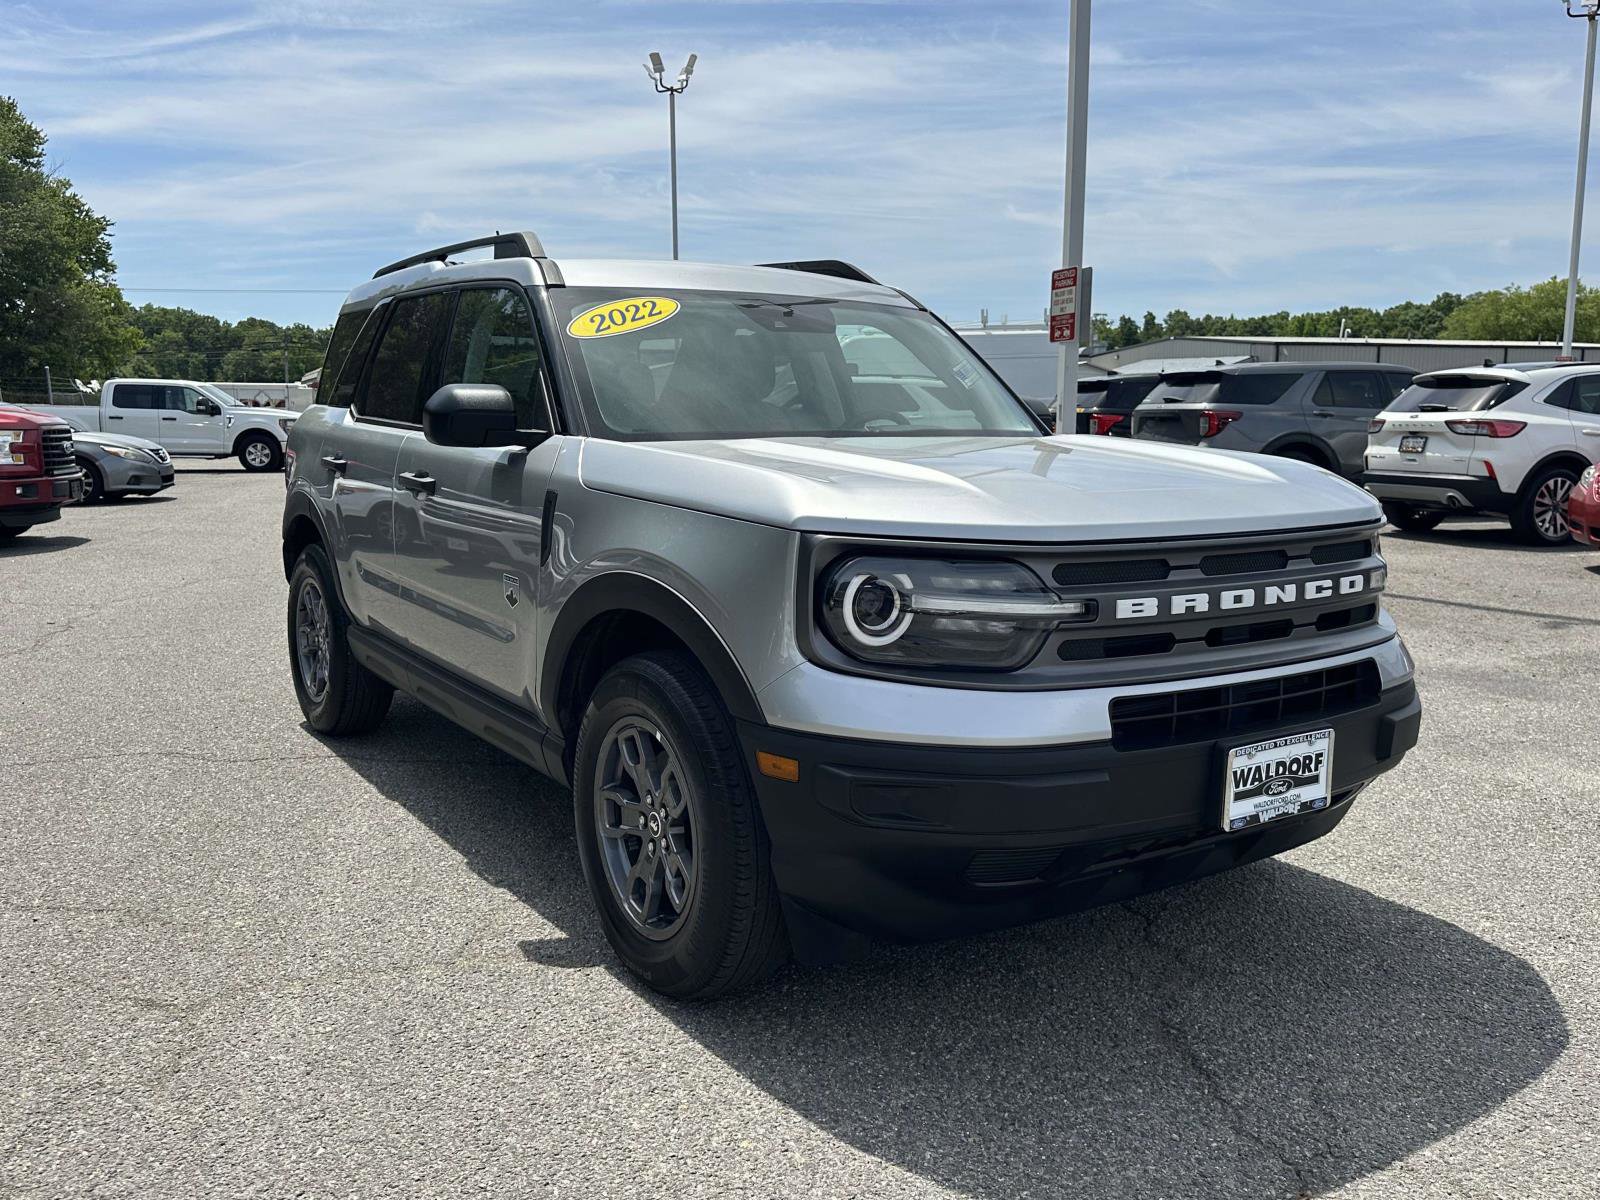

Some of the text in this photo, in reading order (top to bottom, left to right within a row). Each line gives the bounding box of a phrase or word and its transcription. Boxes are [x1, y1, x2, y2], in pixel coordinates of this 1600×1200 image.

[1053, 269, 1076, 280] RESERVED
[1055, 278, 1074, 288] PARKING
[589, 300, 662, 334] 2022
[1115, 574, 1364, 619] BRONCO
[1236, 731, 1330, 756] DEDICATED TO EXCELLENCE
[1232, 752, 1324, 790] WALDORF
[1268, 780, 1289, 795] Ford
[1253, 793, 1302, 810] WALDORFFORD.COM
[1259, 802, 1301, 823] WALDORF
